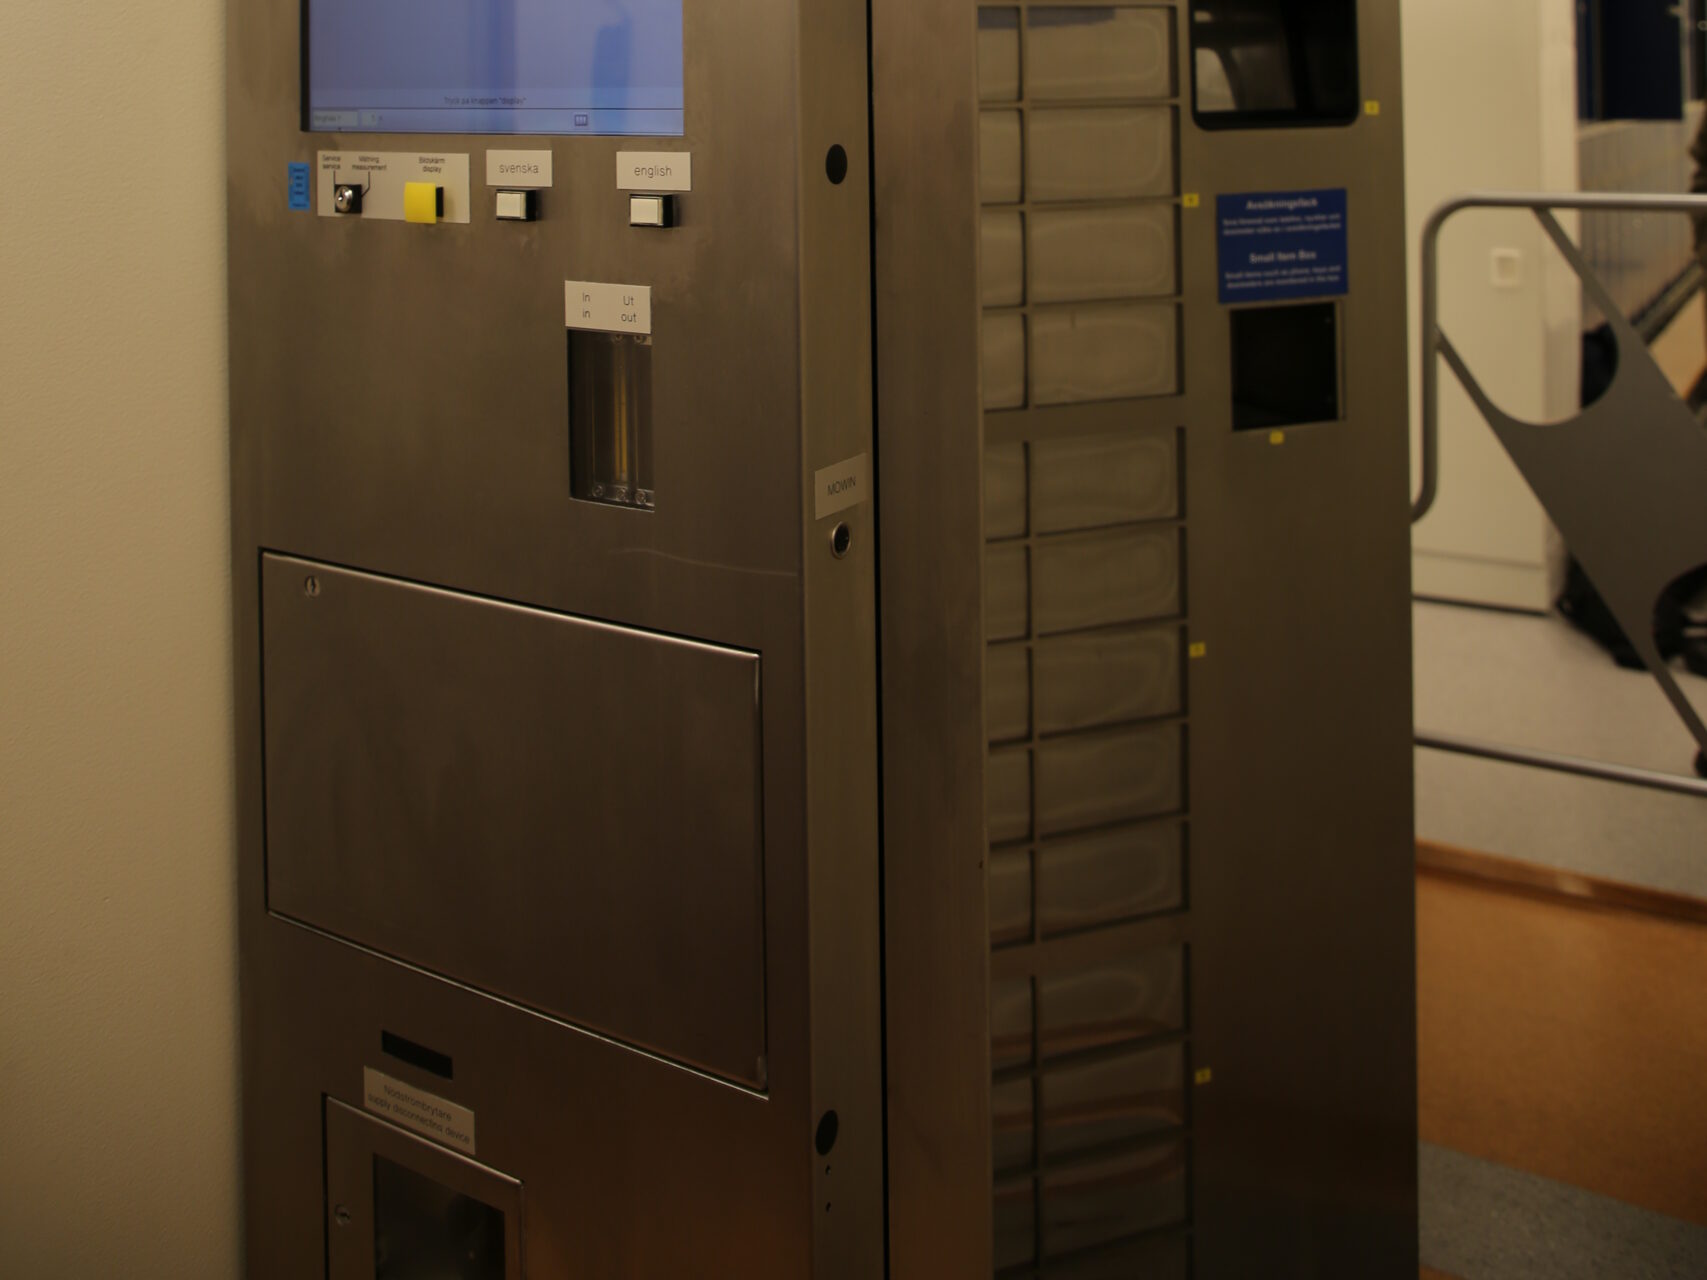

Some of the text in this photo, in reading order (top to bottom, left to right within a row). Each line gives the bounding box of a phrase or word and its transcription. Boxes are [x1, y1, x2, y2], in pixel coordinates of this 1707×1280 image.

[499, 162, 539, 174] svenska
[634, 164, 672, 179] english
[622, 296, 634, 306] Ut
[582, 308, 591, 318] in
[620, 313, 637, 323] out
